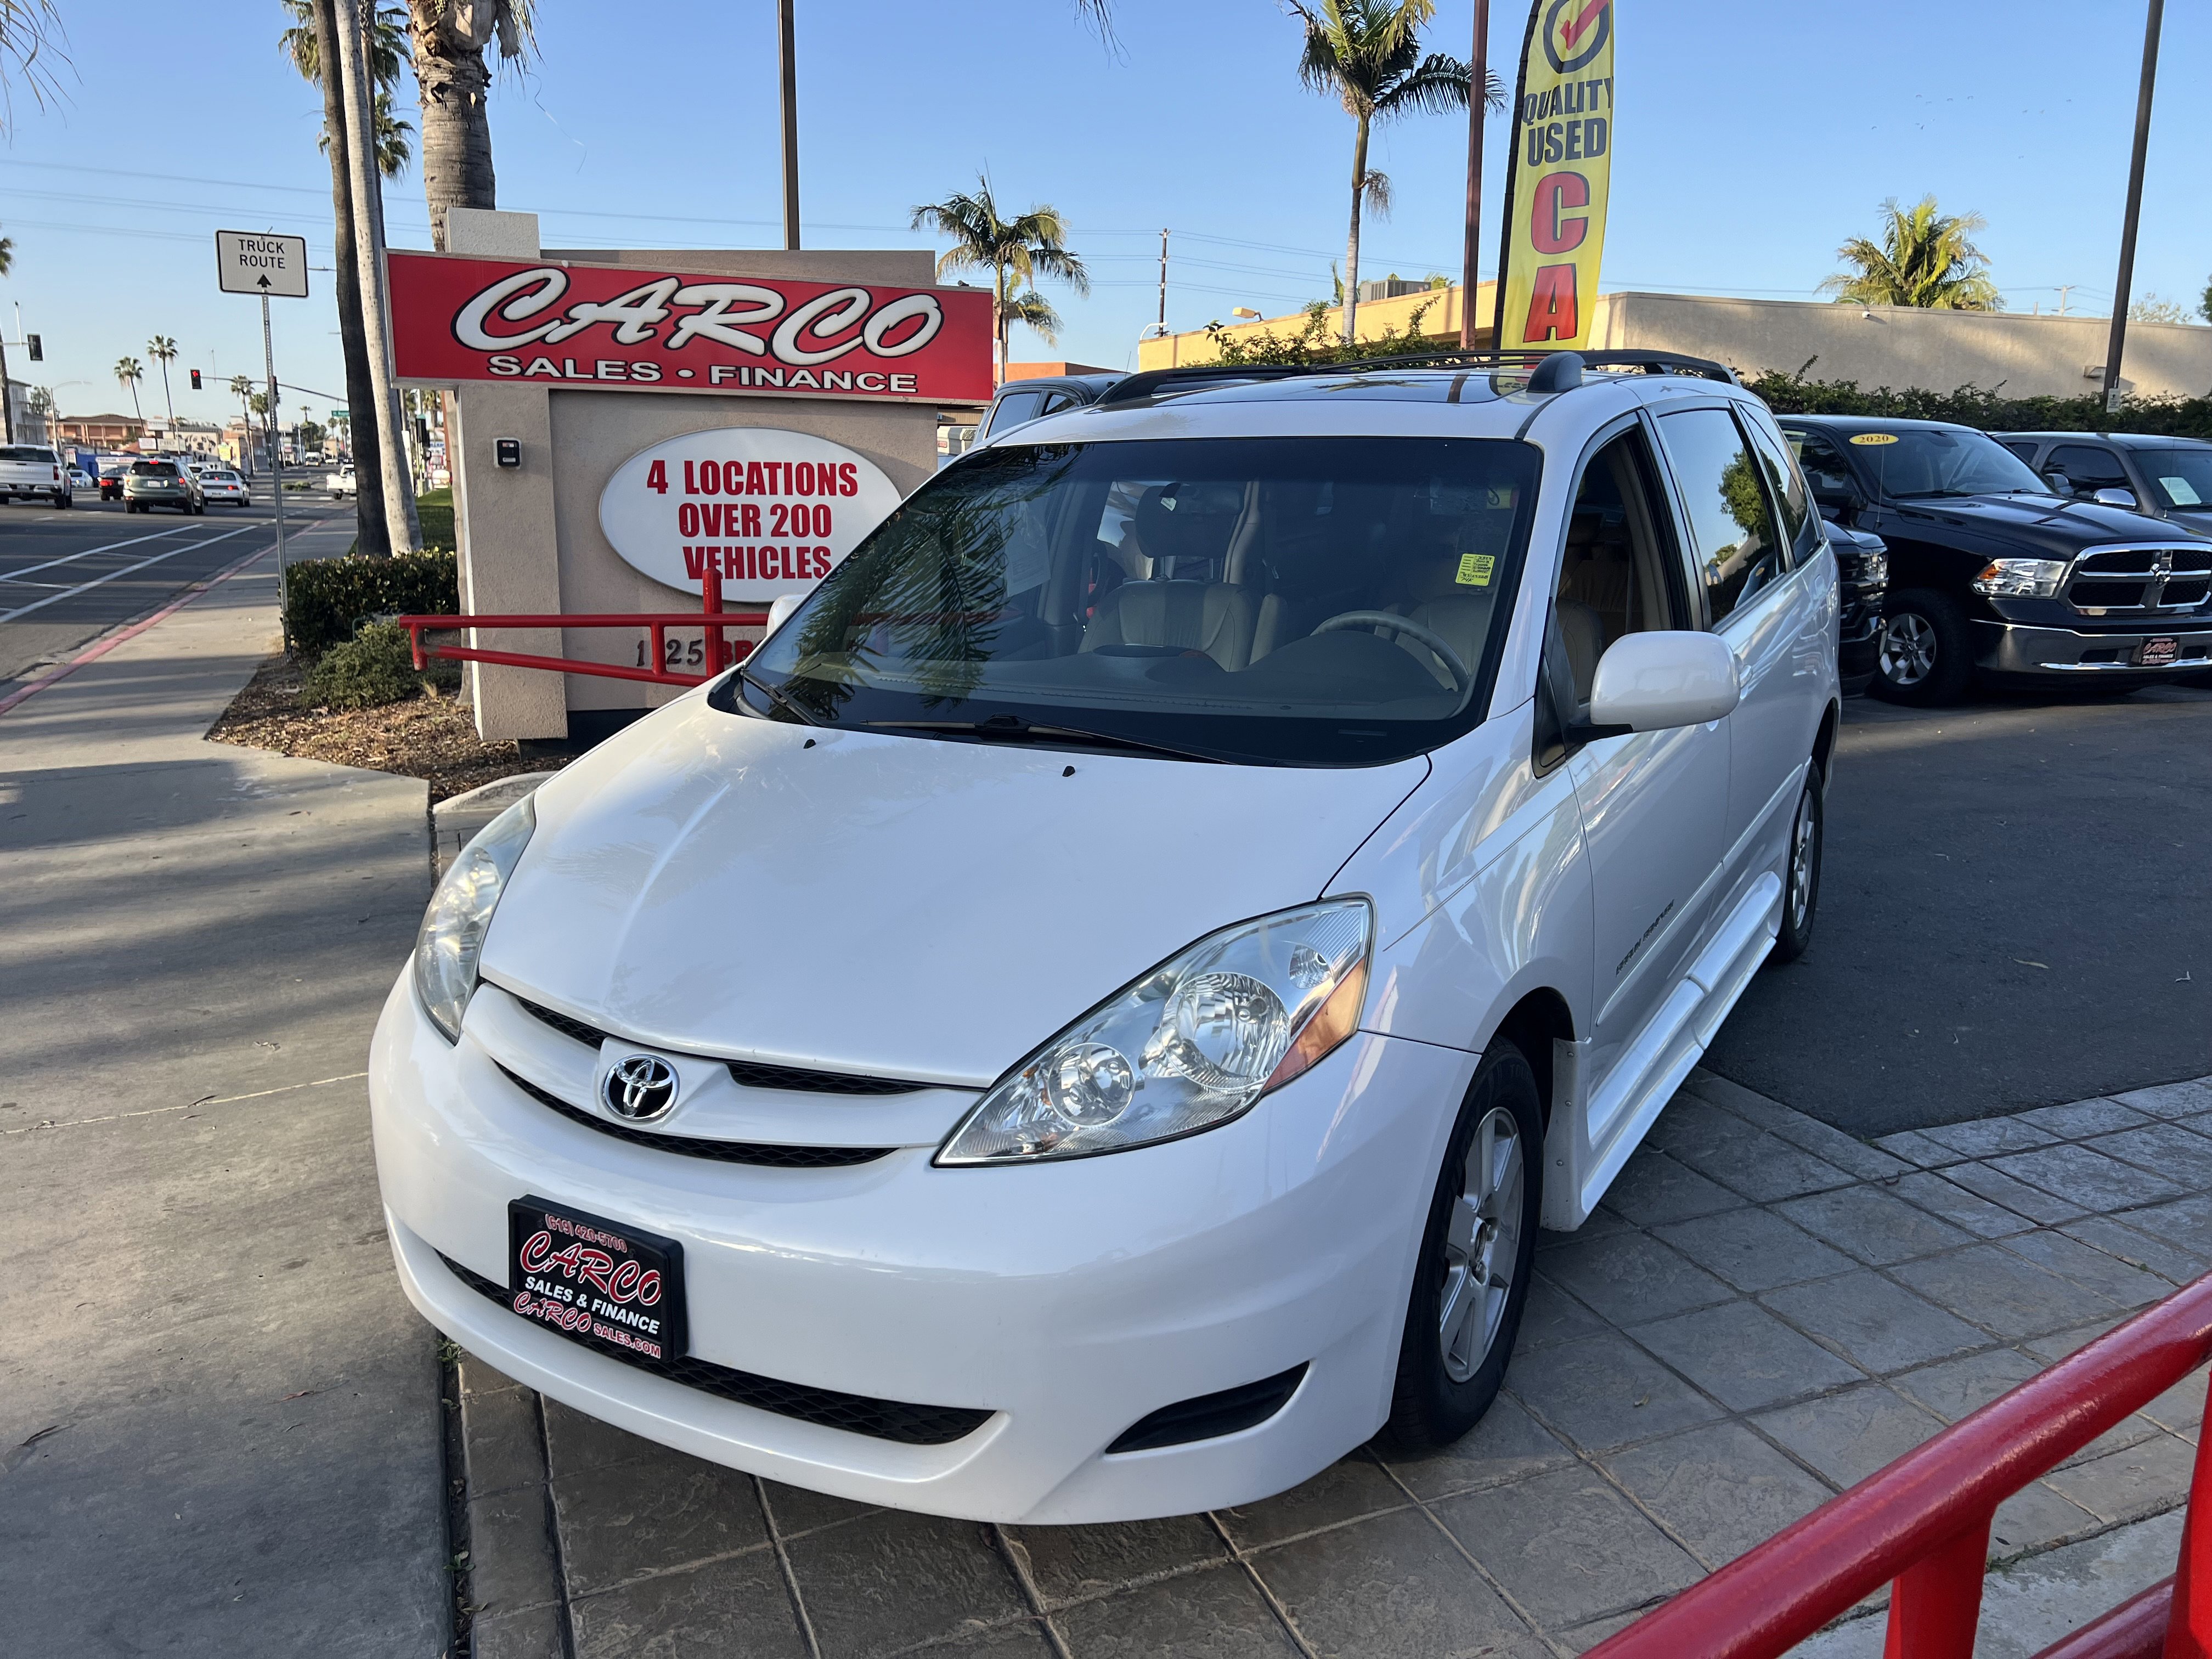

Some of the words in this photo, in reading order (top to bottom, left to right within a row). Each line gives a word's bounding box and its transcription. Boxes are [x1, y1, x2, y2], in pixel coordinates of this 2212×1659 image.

[1522, 76, 1613, 126] QUALITY
[1527, 117, 1607, 167] USED
[238, 239, 285, 254] TRUCK
[240, 254, 285, 269] ROUTE
[1523, 171, 1590, 369] CA
[451, 267, 945, 367] CARCO
[488, 356, 662, 382] SALES
[709, 365, 918, 393] FINANCE
[1859, 435, 1889, 443] 2020
[647, 460, 668, 494] 4
[684, 460, 857, 496] LOCATIONS
[679, 503, 761, 537] OVER
[770, 504, 832, 537] 200
[682, 546, 832, 579] VEHICLES
[637, 639, 703, 666] 125
[545, 1214, 574, 1237] (619)
[575, 1224, 628, 1253] 420-5700
[521, 1231, 662, 1306] CARCO
[525, 1276, 573, 1302] SALES
[576, 1293, 588, 1308] &
[591, 1299, 660, 1334] FINANCE
[514, 1291, 592, 1332] CARCO
[593, 1323, 661, 1359] SALES.COM
